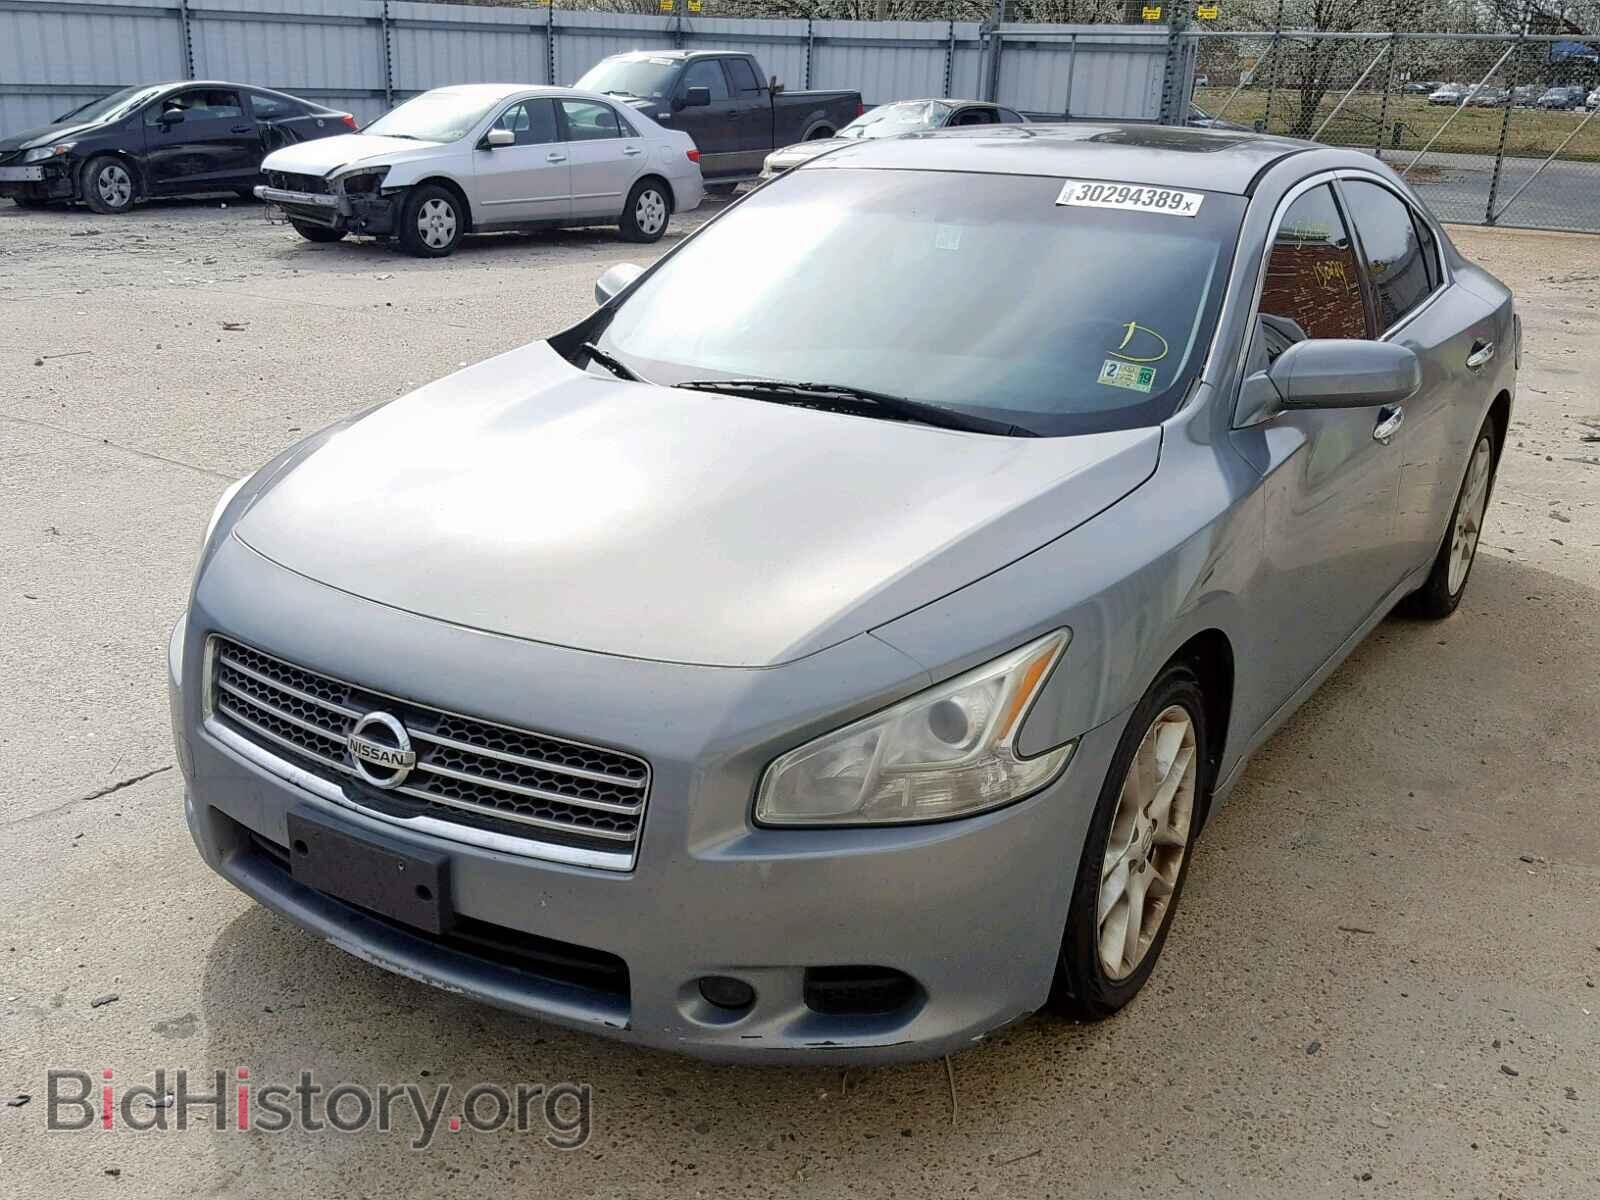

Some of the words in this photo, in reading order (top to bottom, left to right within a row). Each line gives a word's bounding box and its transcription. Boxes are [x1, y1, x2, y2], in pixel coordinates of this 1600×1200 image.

[1106, 363, 1118, 378] 2
[1138, 372, 1152, 385] 19
[349, 739, 404, 766] NISSAN
